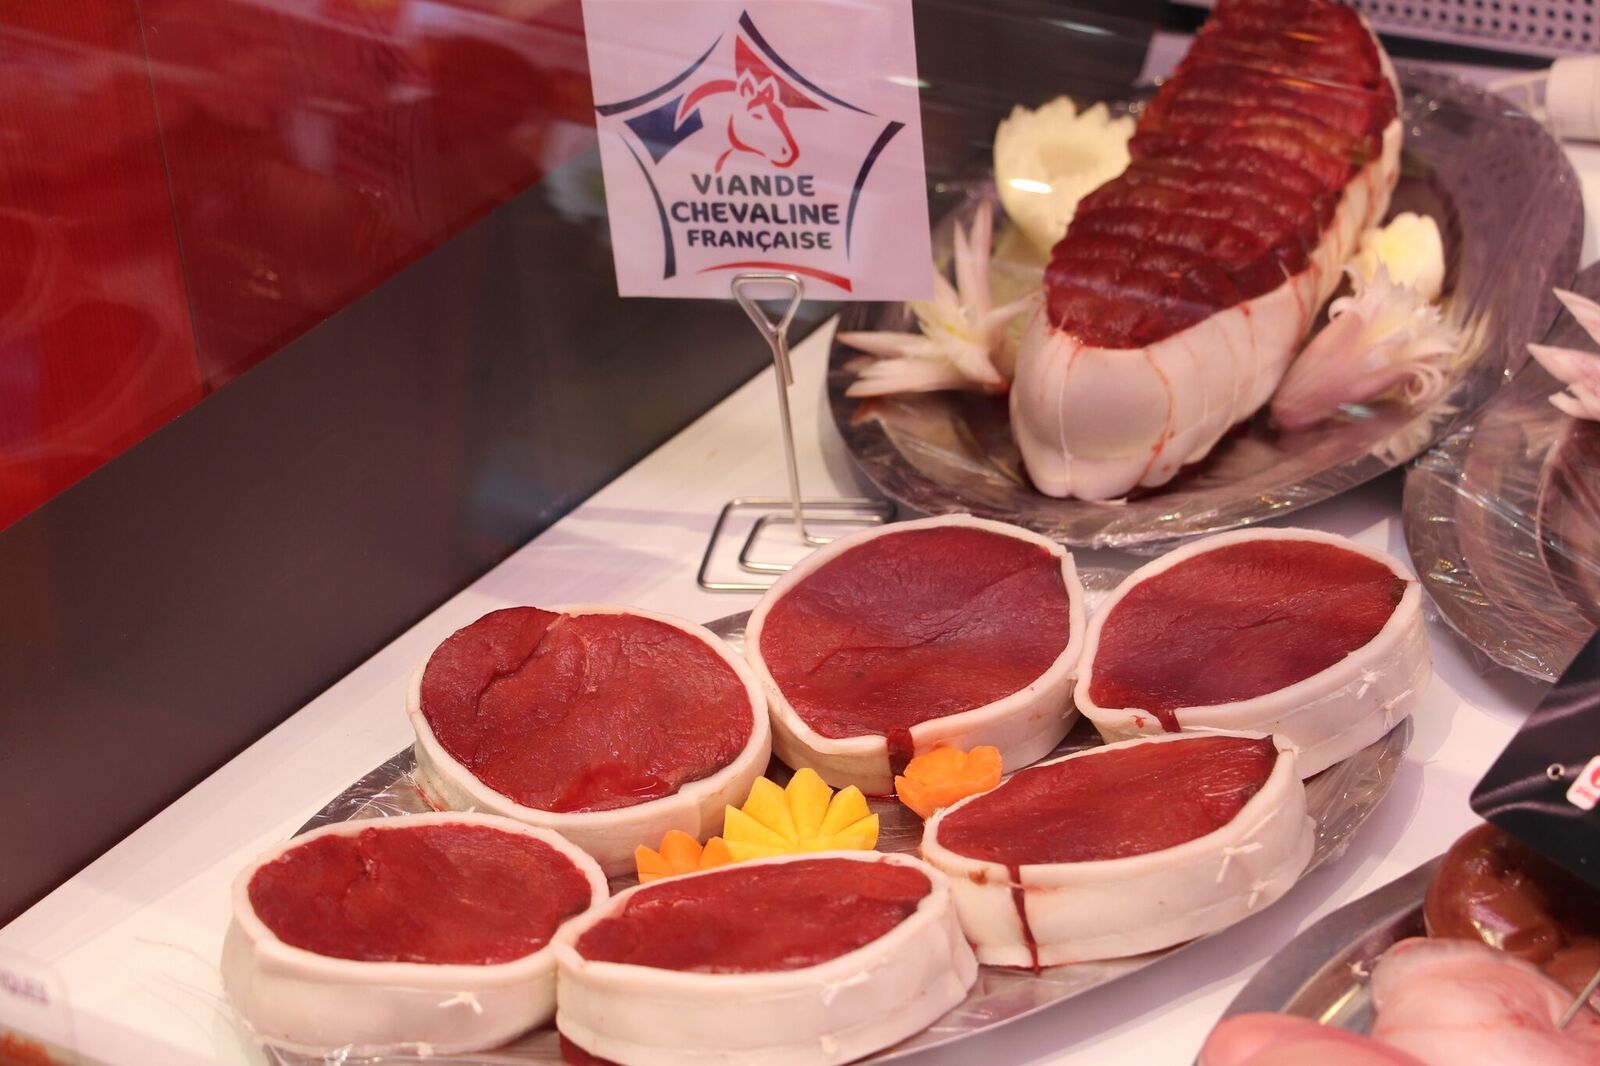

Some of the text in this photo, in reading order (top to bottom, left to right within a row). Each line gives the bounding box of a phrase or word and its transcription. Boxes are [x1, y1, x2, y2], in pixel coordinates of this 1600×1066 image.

[691, 173, 816, 197] VIANDE
[670, 201, 841, 225] CHEVALINE
[687, 229, 833, 253] FRANÇAISE
